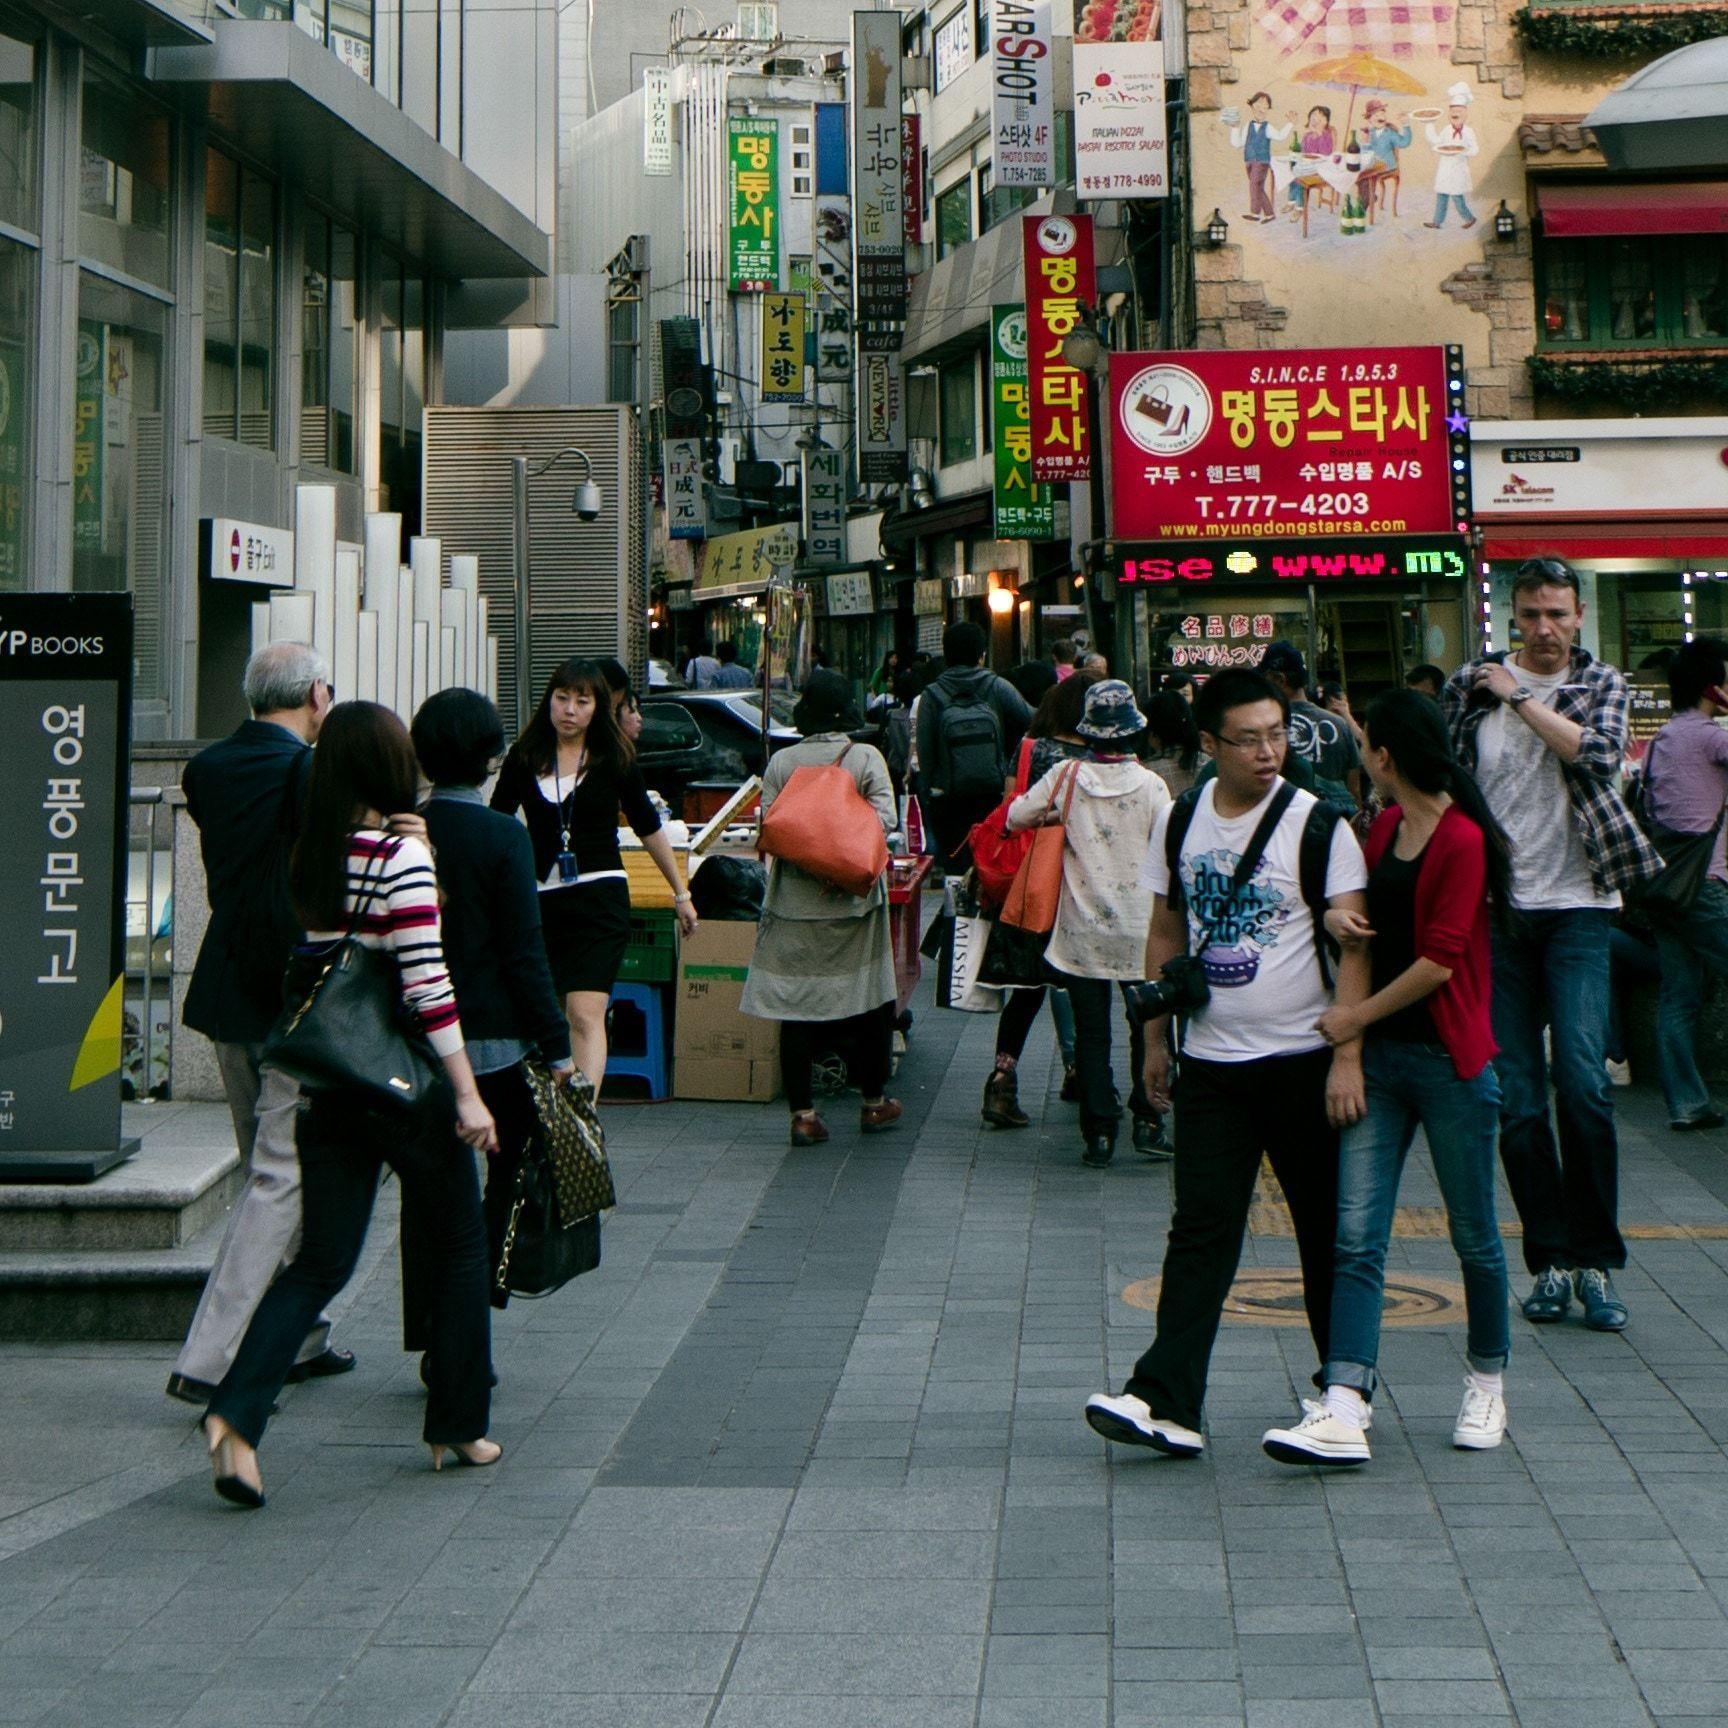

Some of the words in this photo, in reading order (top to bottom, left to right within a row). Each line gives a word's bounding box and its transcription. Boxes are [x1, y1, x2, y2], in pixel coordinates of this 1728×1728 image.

[651, 78, 668, 145] 中古名品
[999, 125, 1032, 148] 스타샷
[1035, 125, 1049, 146] 4F
[1000, 152, 1022, 163] PHOTO
[1024, 152, 1048, 164] STUDIO
[737, 136, 773, 238] 명동사
[866, 334, 899, 349] cafe
[1040, 256, 1086, 453] 명동스타사
[1249, 366, 1327, 384] S.I.N.C.E
[1339, 363, 1399, 382] 1.9.5.3
[1221, 385, 1431, 449] 명동스타사
[1328, 446, 1371, 458] Repair
[1378, 445, 1419, 457] House
[1143, 465, 1181, 485] 구두
[1205, 463, 1262, 484] 핸드백
[1298, 462, 1374, 483] 수입명품
[1381, 459, 1423, 480] A/S
[674, 476, 697, 519] 成元
[1502, 485, 1517, 495] SK
[810, 454, 843, 561] 세화번역
[1195, 492, 1371, 519] T.777-4203
[1159, 518, 1407, 538] www.myungdongstarsa.com
[1181, 615, 1273, 638] 名品修繕
[30, 636, 104, 656] BOOKS
[37, 702, 86, 985] 영풍문고
